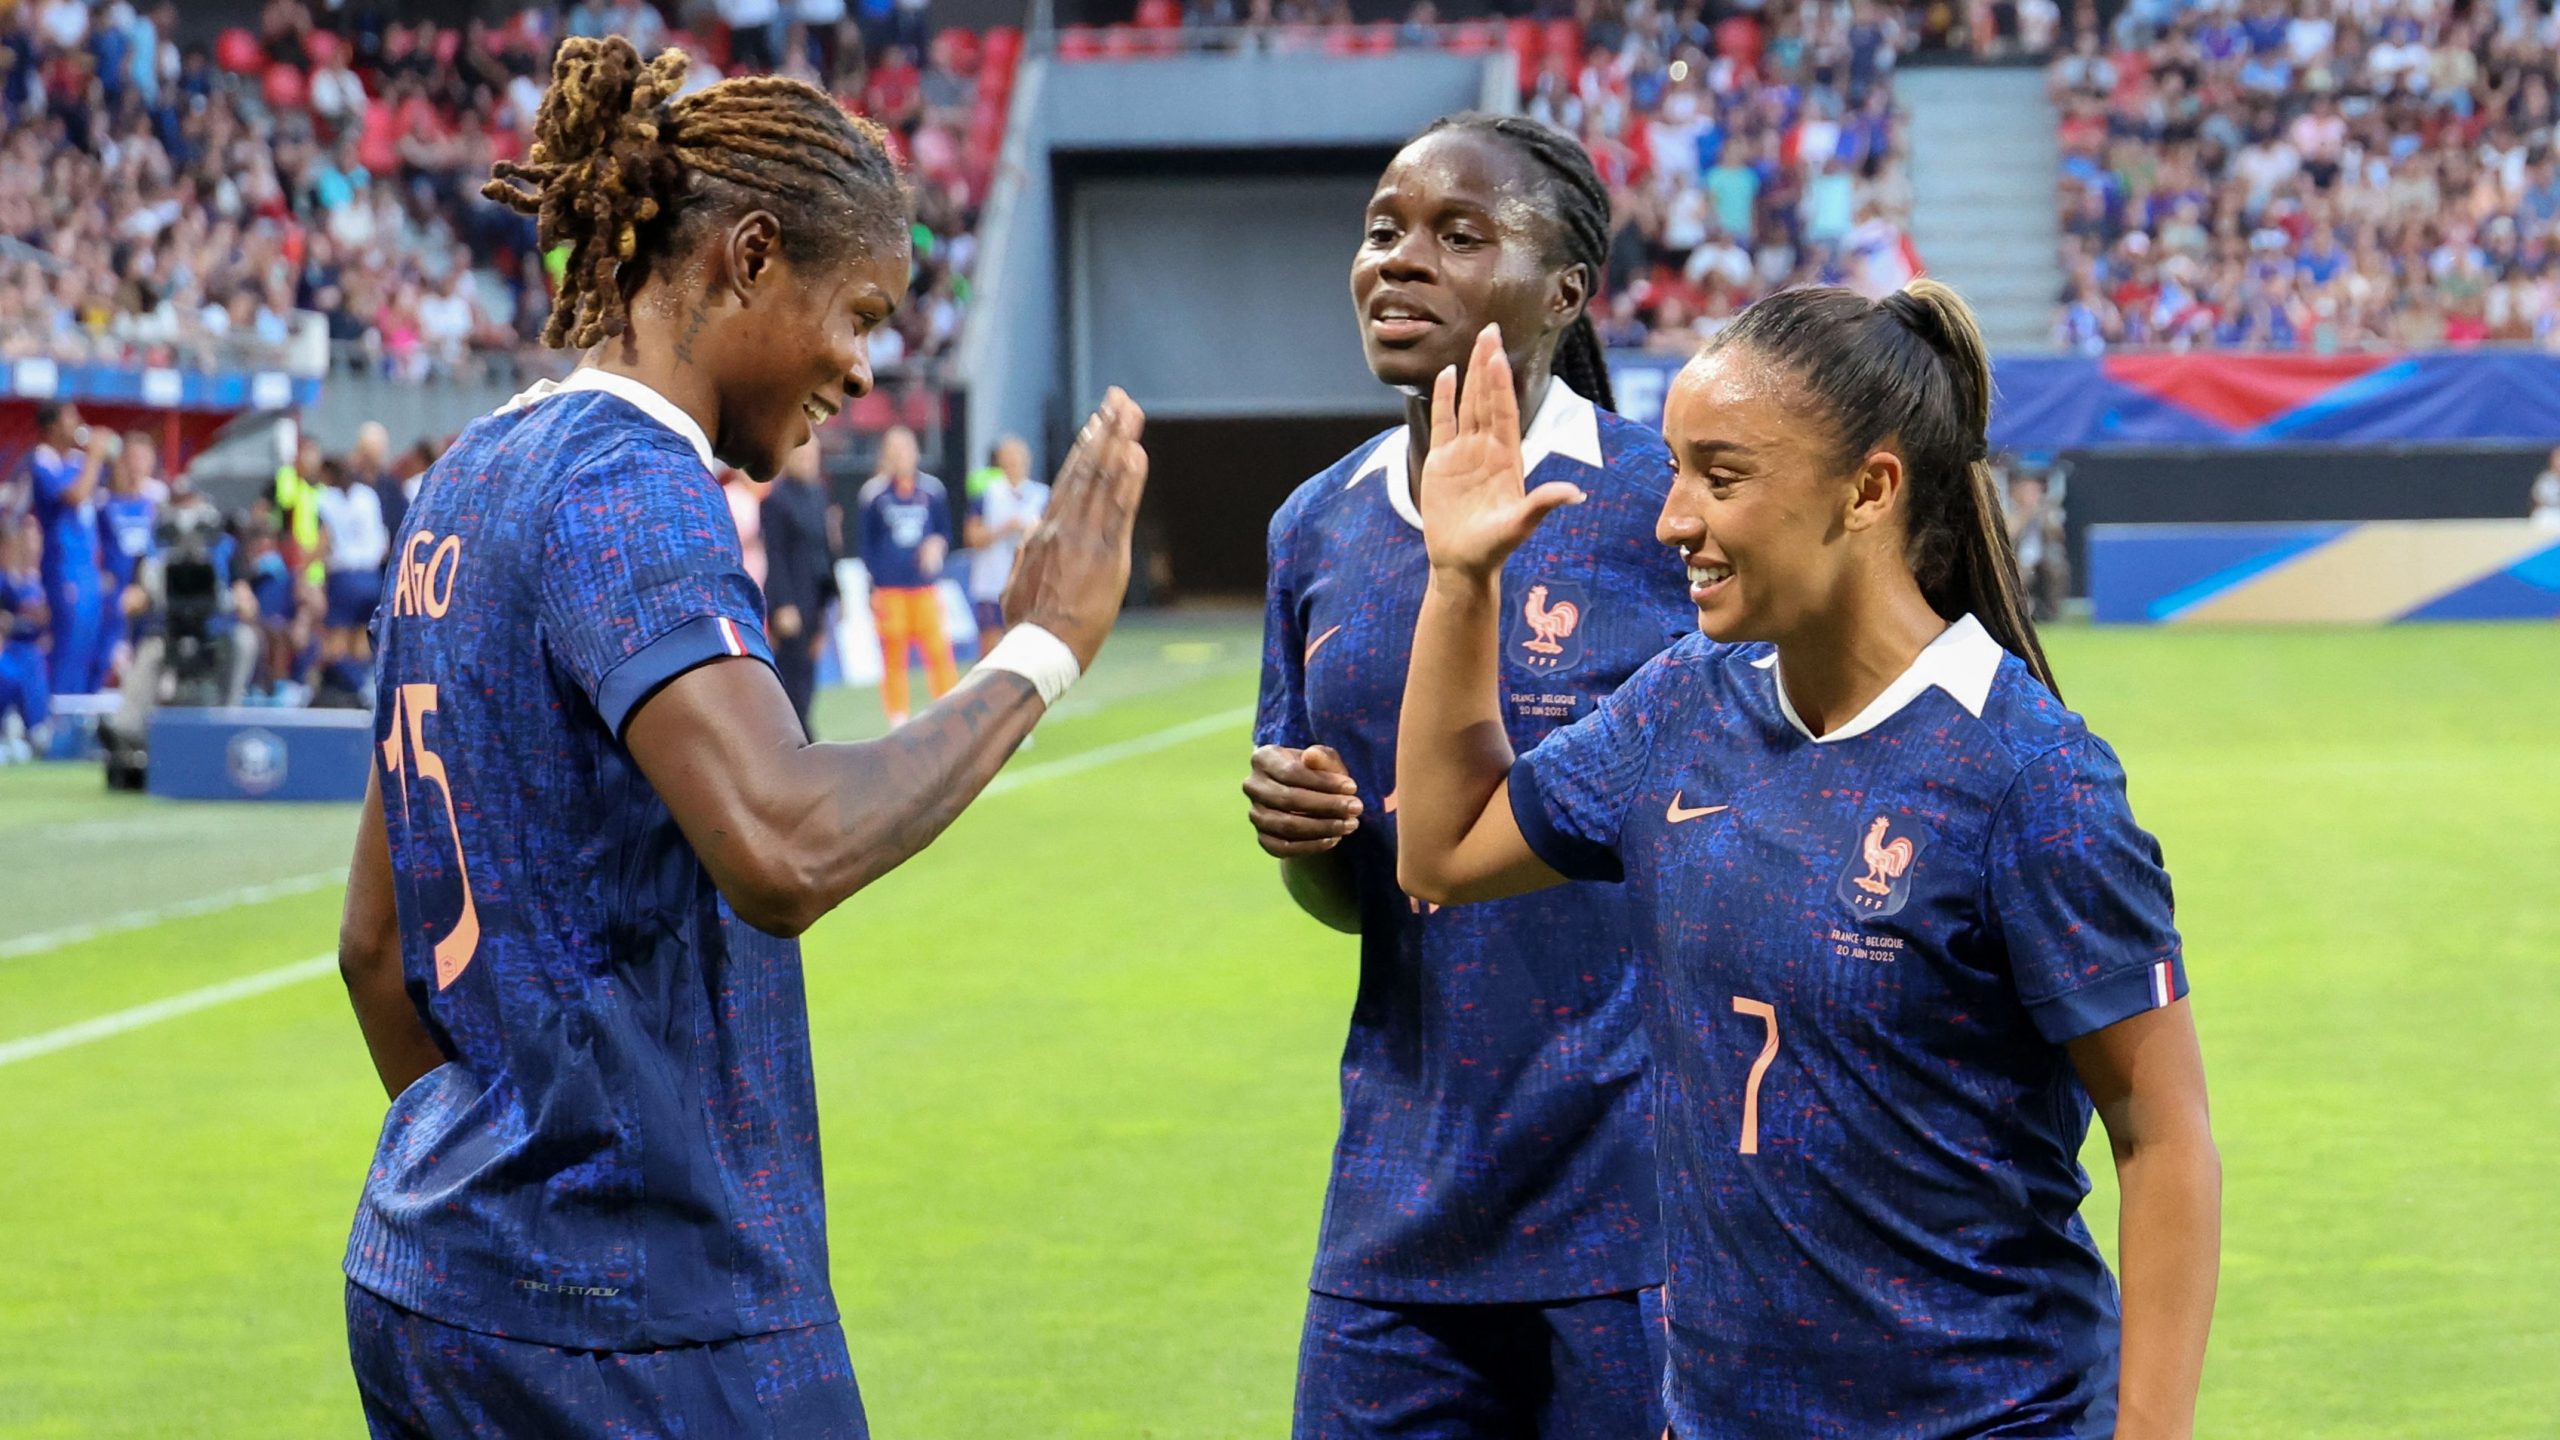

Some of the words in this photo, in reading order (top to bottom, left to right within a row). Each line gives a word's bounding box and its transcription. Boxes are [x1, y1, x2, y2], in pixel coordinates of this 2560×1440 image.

[1519, 706, 1530, 714] 20
[1544, 707, 1568, 716] 2025
[383, 683, 480, 991] 15
[1831, 930, 1859, 943] FRANCE
[1865, 936, 1904, 949] BELGIQUE
[1836, 945, 1849, 956] 20
[1851, 947, 1868, 959] JUIN
[1869, 950, 1895, 962] 2025
[1732, 995, 1780, 1154] 7
